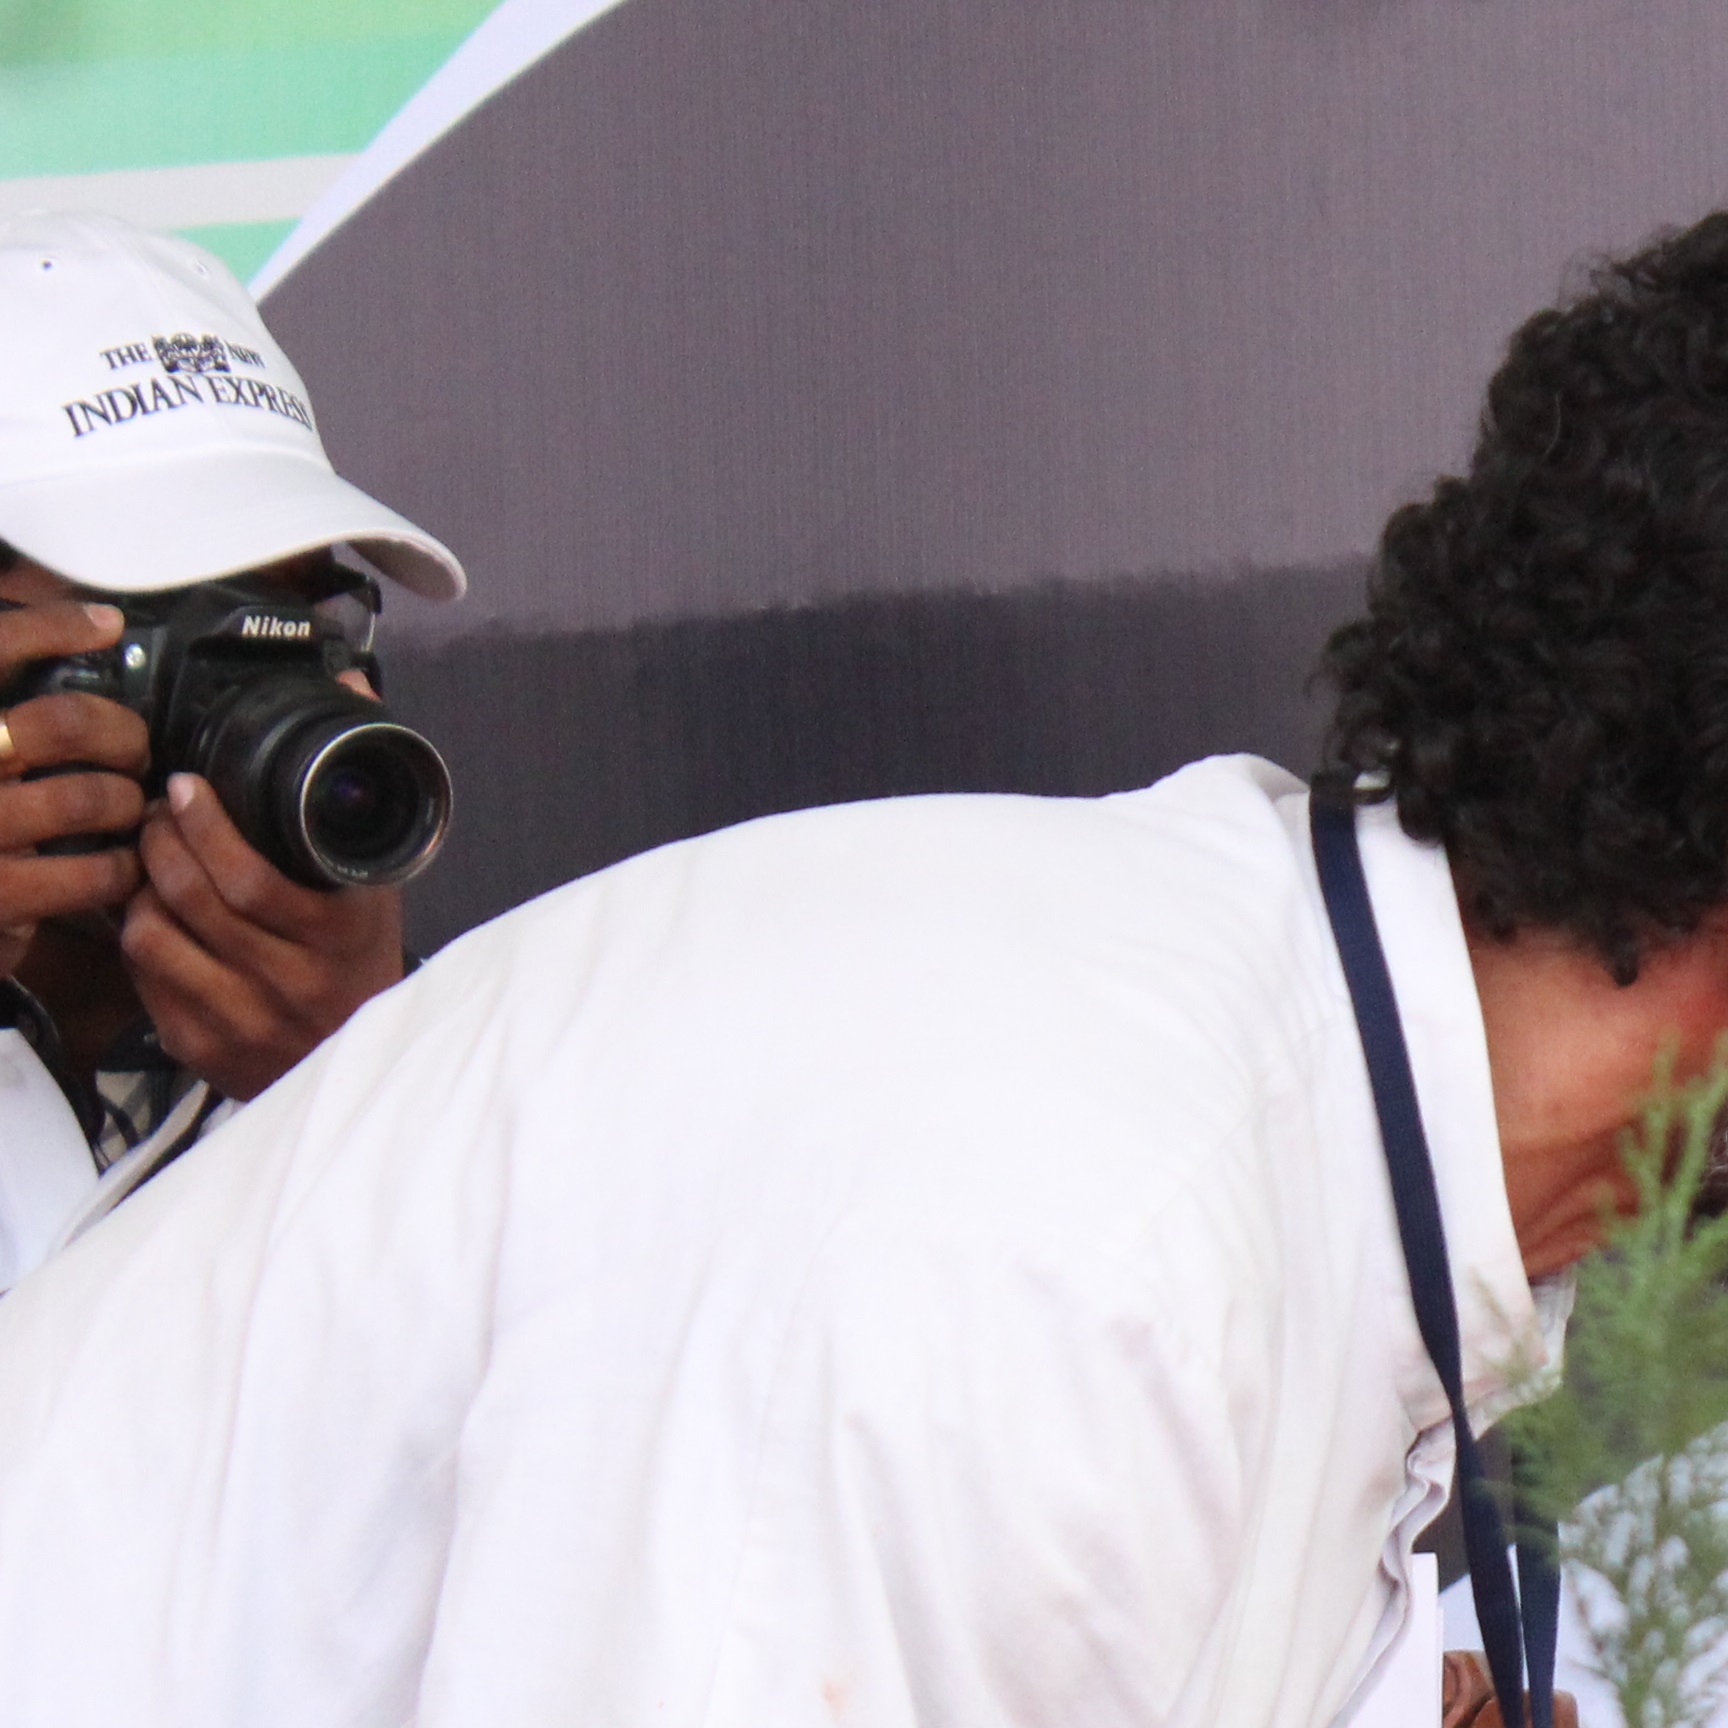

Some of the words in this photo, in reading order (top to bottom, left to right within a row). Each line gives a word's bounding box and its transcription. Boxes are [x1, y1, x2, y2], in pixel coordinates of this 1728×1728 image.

[100, 342, 153, 370] THE
[62, 374, 205, 438] INDIAN
[241, 615, 311, 637] Nikon
